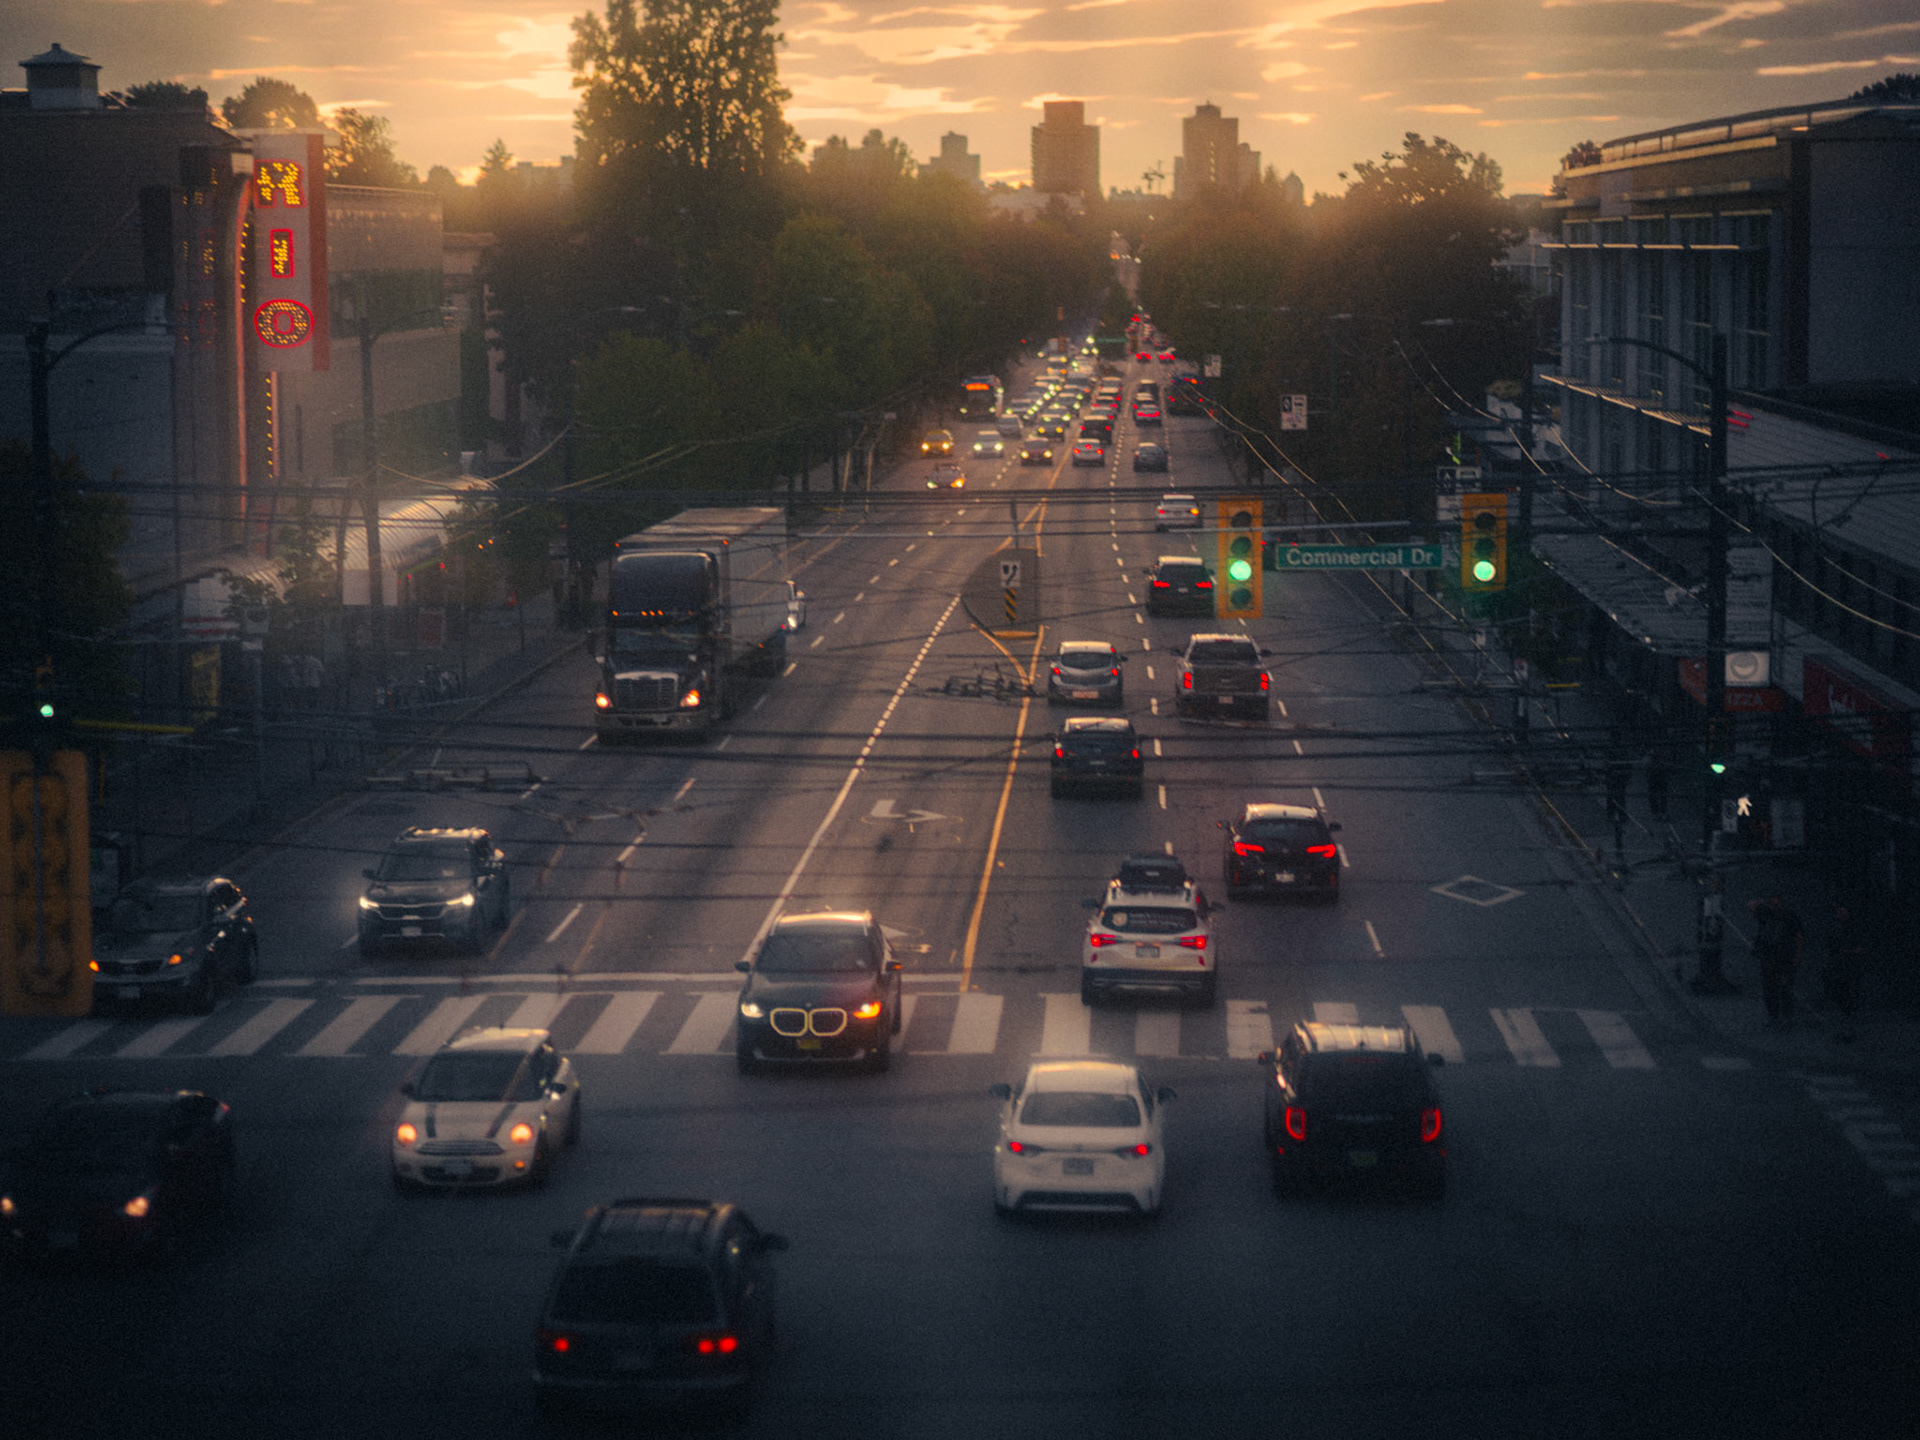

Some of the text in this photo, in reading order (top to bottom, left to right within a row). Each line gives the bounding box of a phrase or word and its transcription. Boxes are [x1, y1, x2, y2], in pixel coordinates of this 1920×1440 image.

[254, 159, 314, 348] RIO
[1286, 549, 1433, 566] Commercial Dr
[1727, 692, 1764, 706] IZZA
